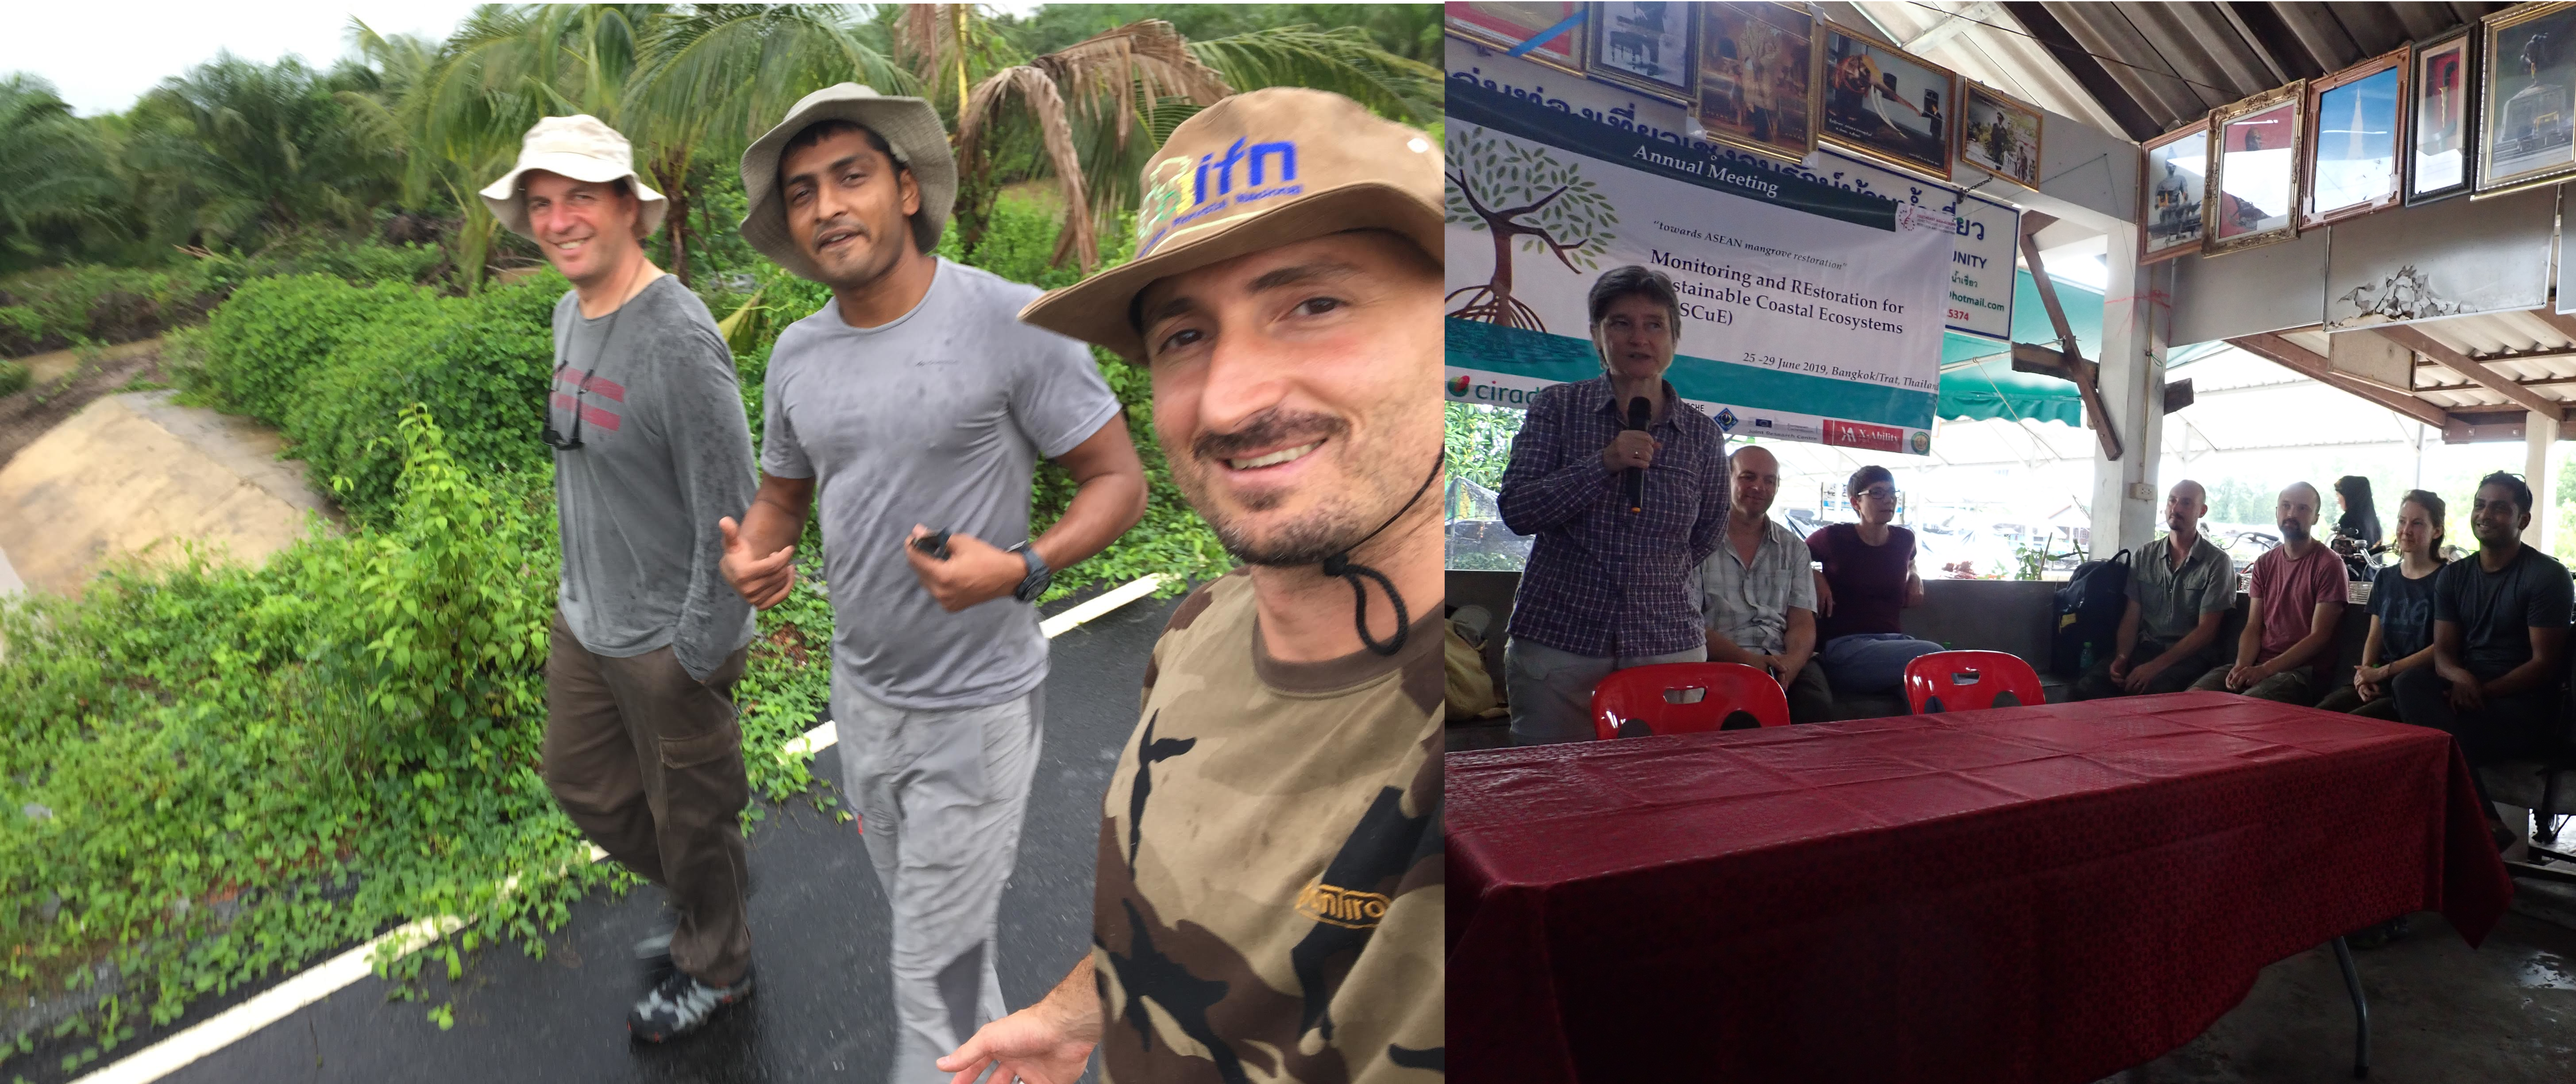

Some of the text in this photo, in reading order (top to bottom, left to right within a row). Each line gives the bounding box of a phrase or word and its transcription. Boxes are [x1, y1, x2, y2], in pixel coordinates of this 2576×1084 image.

[1193, 136, 1297, 205] ifn
[1633, 144, 1704, 175] Annual
[1707, 164, 1778, 198] Meeting
[1704, 232, 1743, 248] ASEAN
[1744, 243, 1792, 258] mangrove
[1650, 249, 1904, 314] Monitoring and REstoration for
[1949, 291, 2005, 311] hotmail.com
[1756, 295, 1813, 318] Coastal
[1819, 307, 1903, 333] Ecosystems
[1743, 352, 1756, 363] 25
[1777, 358, 1800, 371] June
[1803, 362, 1828, 376] 2019,
[1832, 366, 1900, 386] Bangkok/Trat,
[1903, 376, 1939, 391] Thailand
